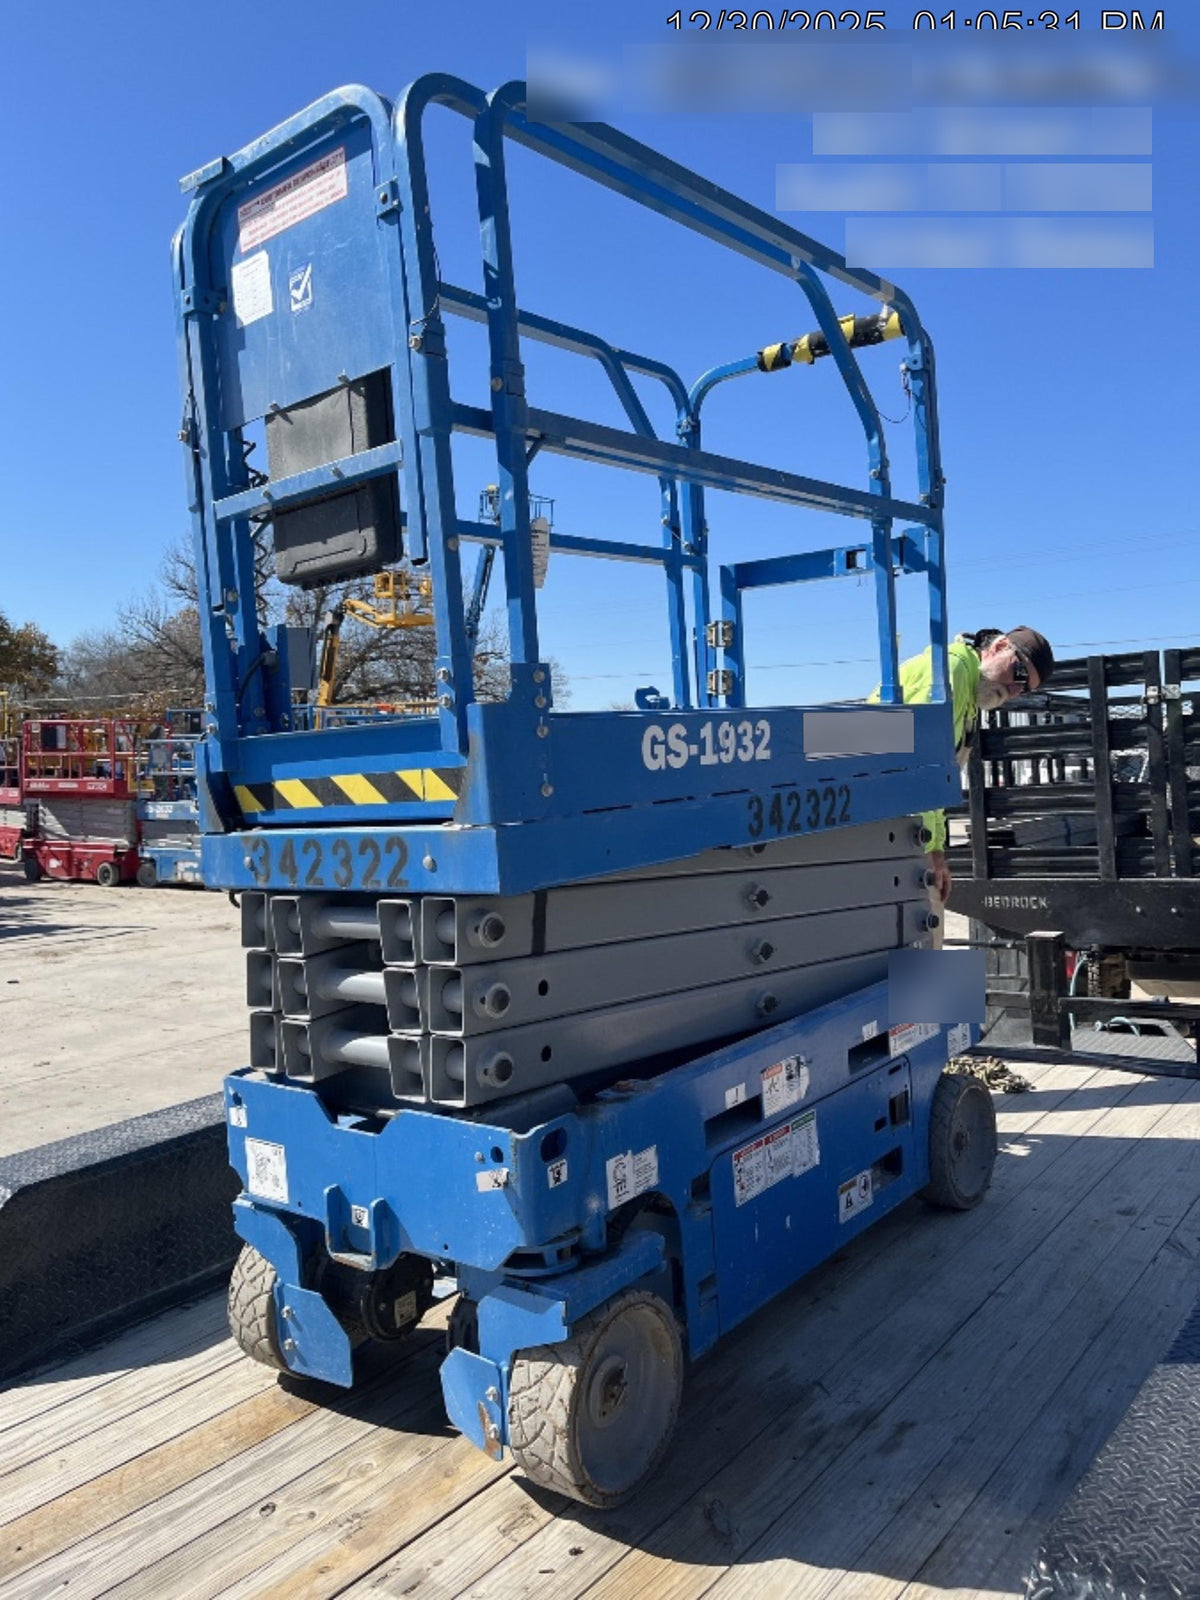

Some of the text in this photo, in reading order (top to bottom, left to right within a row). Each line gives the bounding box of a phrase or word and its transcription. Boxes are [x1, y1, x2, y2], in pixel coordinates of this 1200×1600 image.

[641, 719, 772, 771] GS-1932
[747, 784, 851, 837] 342322
[250, 836, 410, 888] 342322
